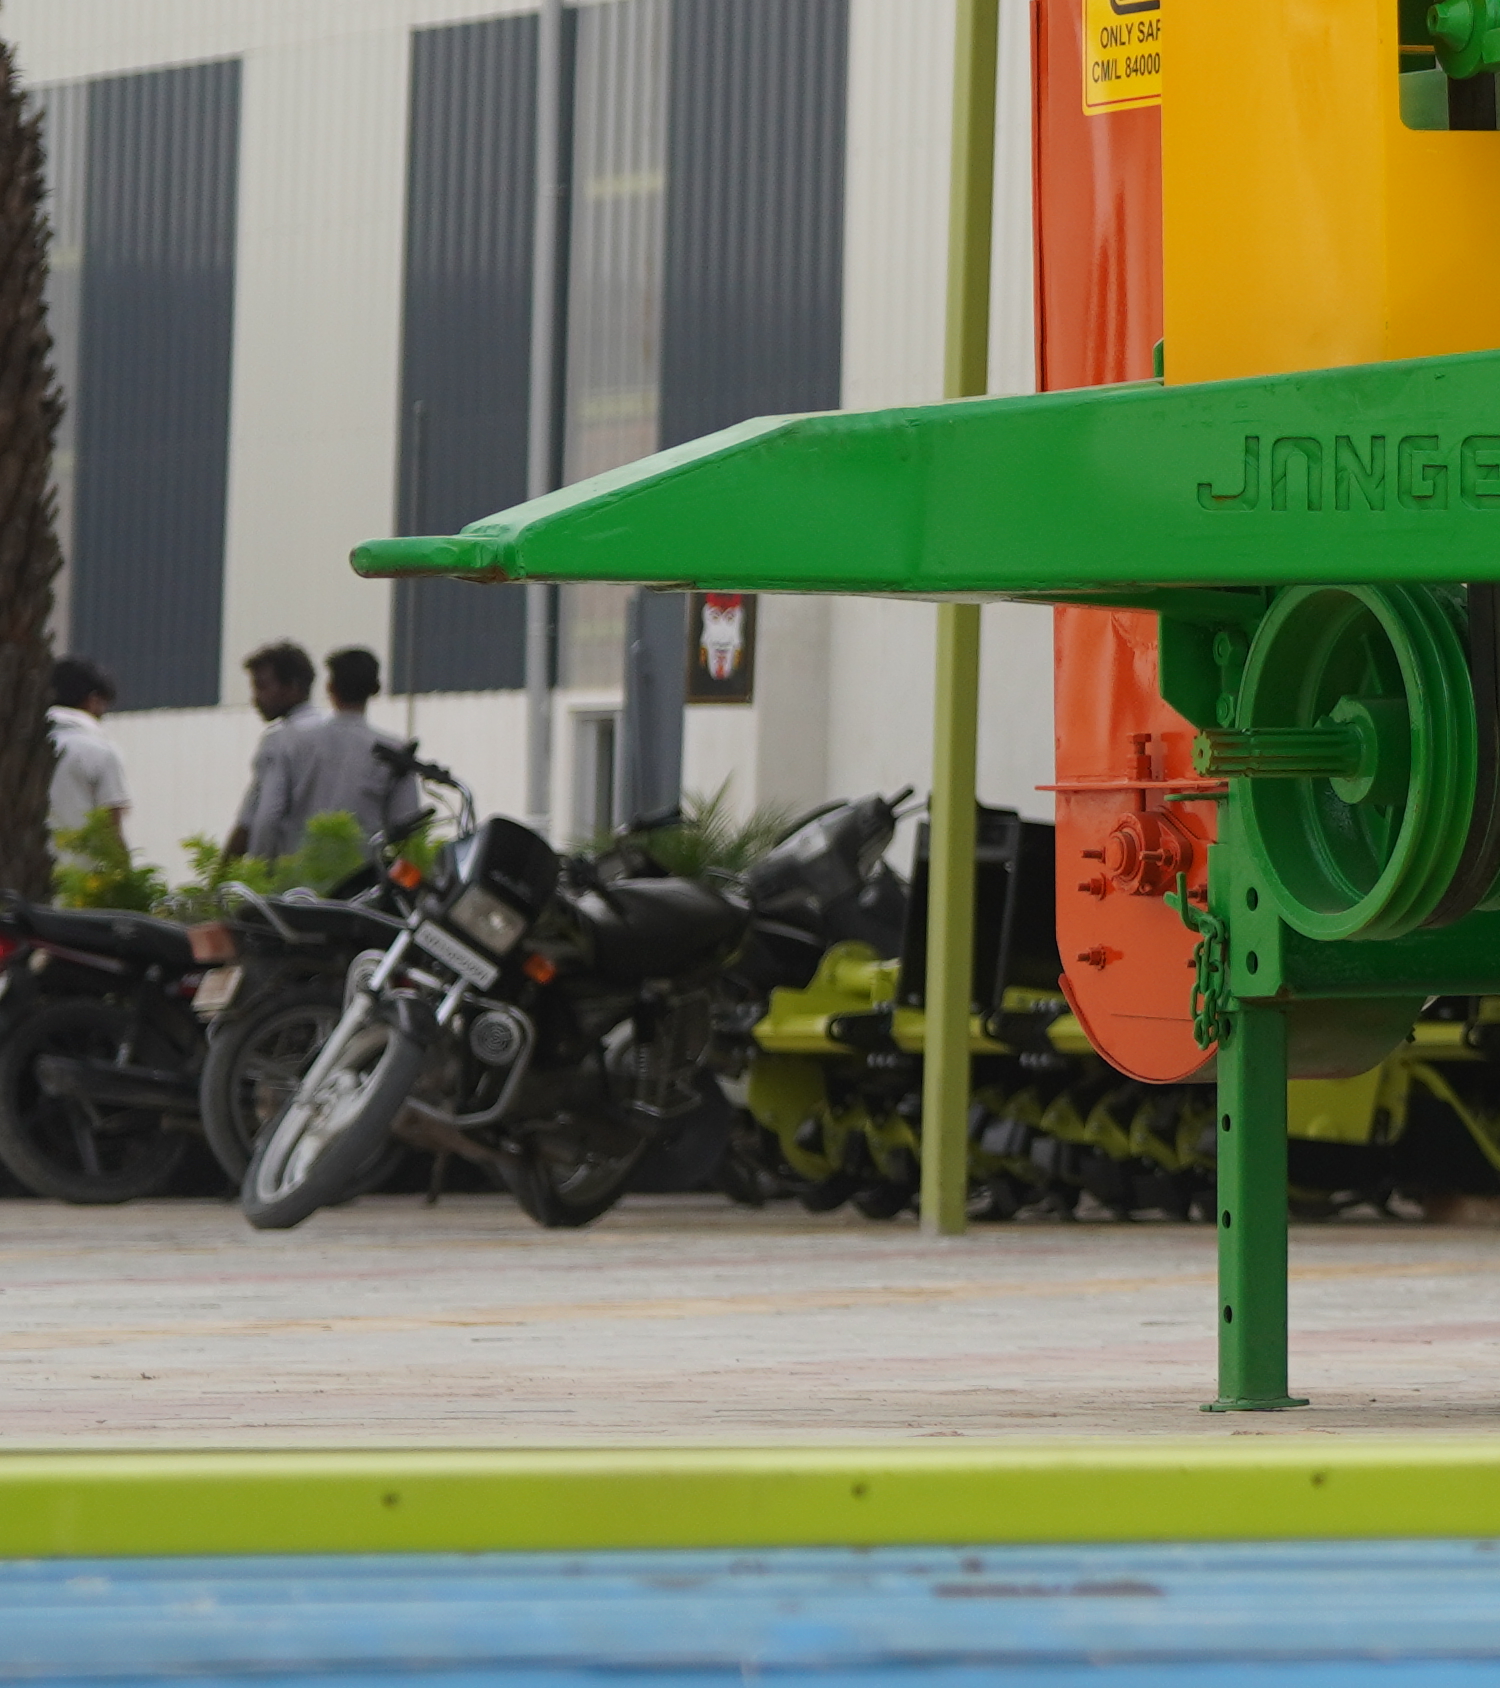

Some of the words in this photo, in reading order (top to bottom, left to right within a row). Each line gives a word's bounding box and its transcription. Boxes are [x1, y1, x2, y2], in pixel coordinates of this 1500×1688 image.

[1100, 22, 1134, 50] ONLY
[1136, 18, 1161, 43] SAF
[1092, 57, 1122, 84] CM/L
[1125, 51, 1161, 79] 84000
